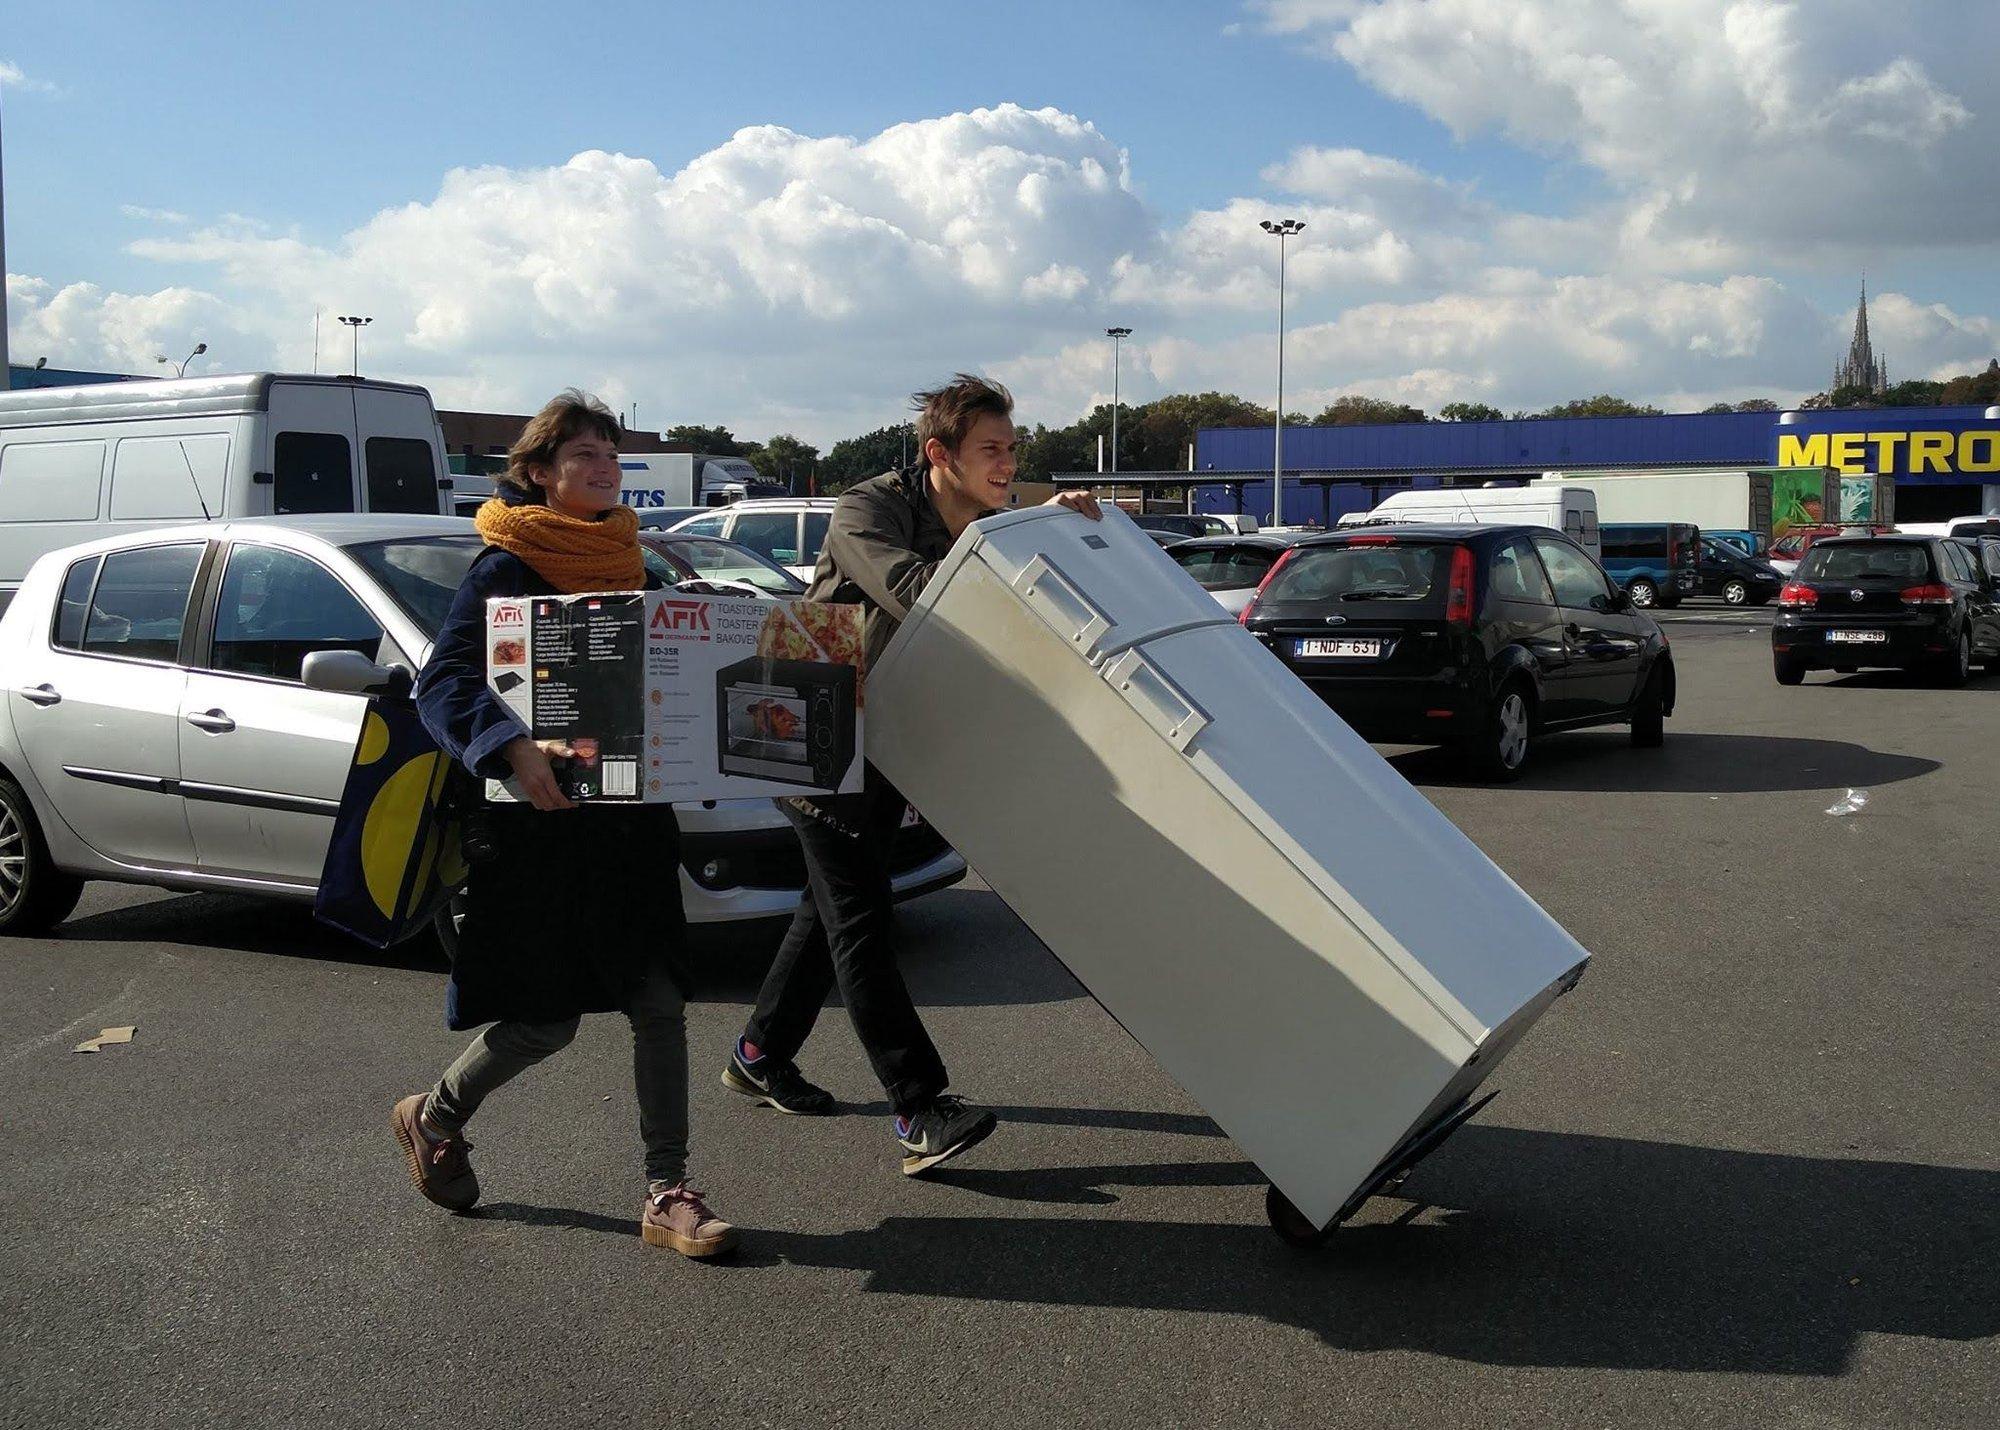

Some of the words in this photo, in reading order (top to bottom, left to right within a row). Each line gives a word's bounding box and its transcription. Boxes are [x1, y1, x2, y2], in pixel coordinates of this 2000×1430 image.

[1779, 431, 2000, 473] METRO
[717, 618, 759, 630] TOASTER
[1306, 640, 1377, 653] 1-NDF-631
